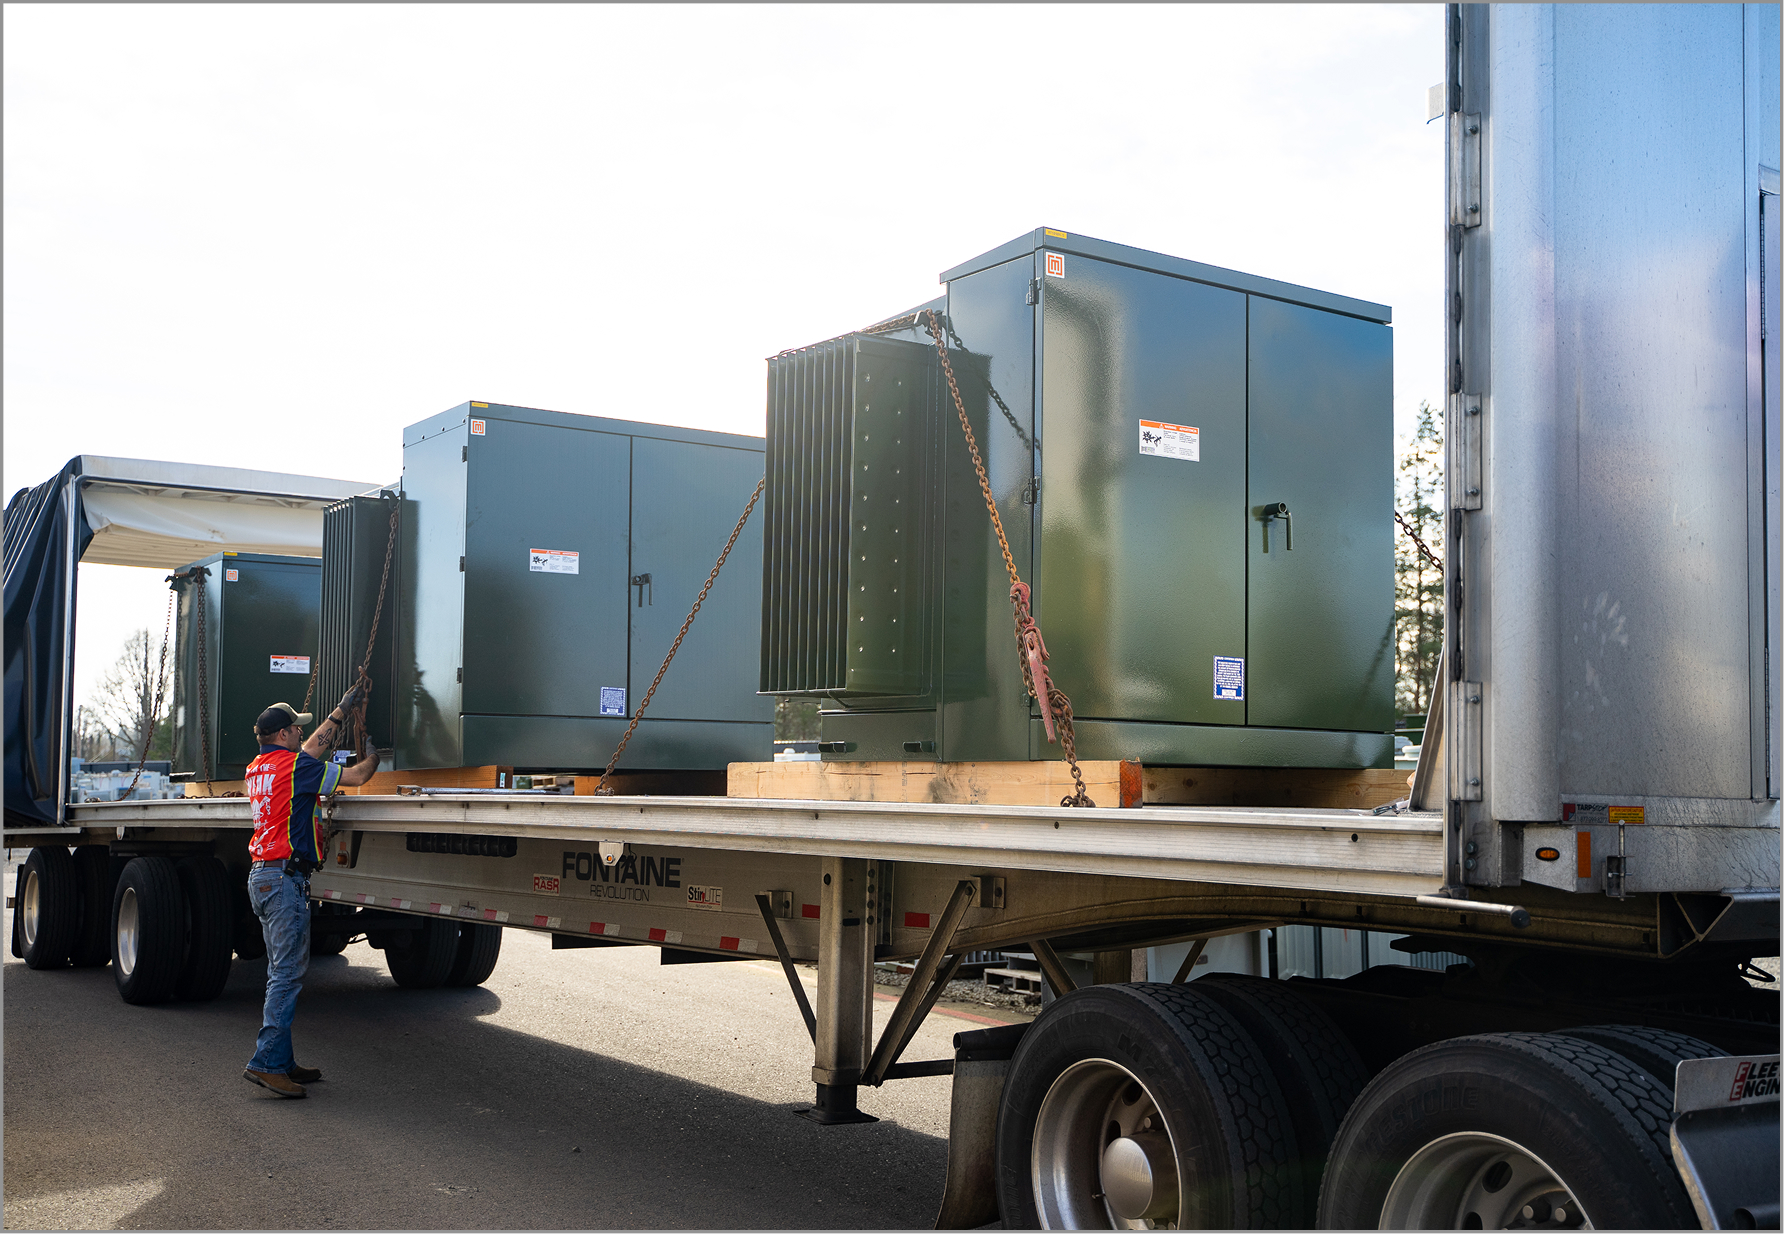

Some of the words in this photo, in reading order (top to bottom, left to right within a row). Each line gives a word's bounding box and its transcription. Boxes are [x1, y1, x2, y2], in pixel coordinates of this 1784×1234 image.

[563, 852, 681, 888] FONTAINE
[534, 877, 559, 894] RASR
[590, 884, 649, 901] REVOLUTION
[1737, 1062, 1780, 1080] FLEE
